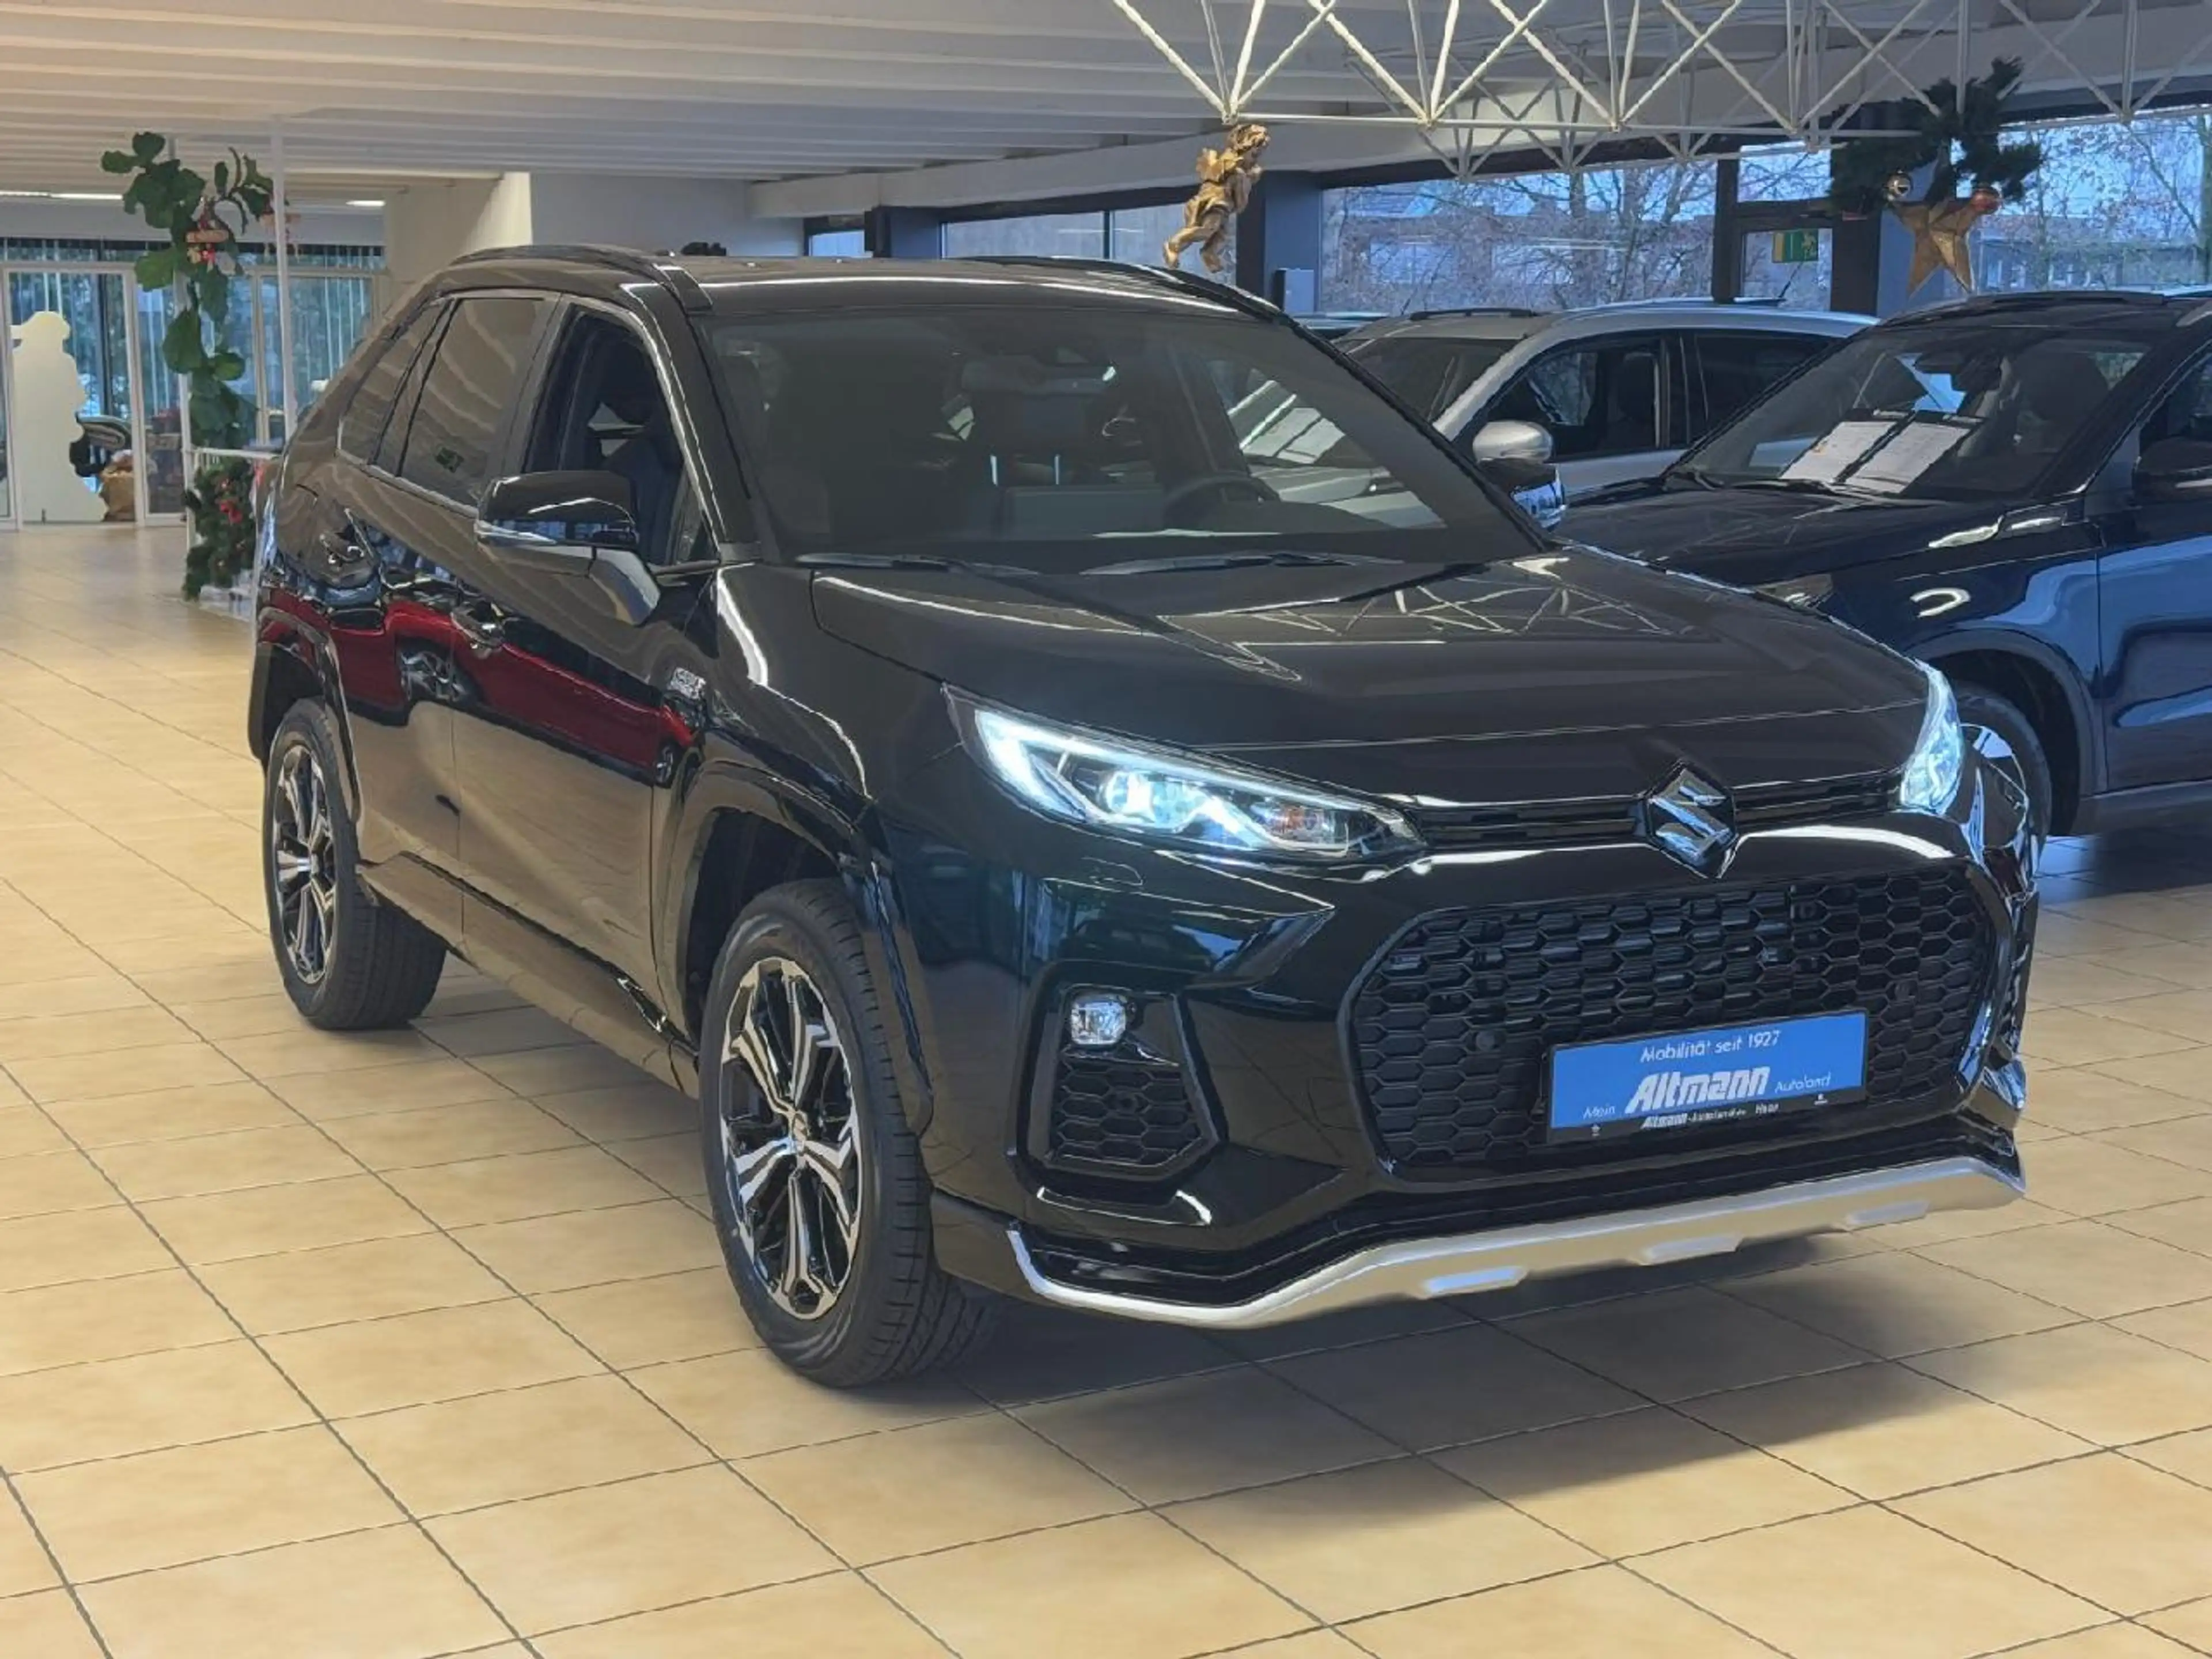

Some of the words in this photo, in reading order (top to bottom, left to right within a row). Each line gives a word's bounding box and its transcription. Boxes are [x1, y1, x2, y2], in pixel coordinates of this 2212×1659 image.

[1714, 1035, 1743, 1054] seit
[1748, 1029, 1781, 1048] 1927
[1582, 1104, 1616, 1119] Mein
[1624, 1066, 1771, 1114] Altmann
[1774, 1071, 1831, 1094] Autoland
